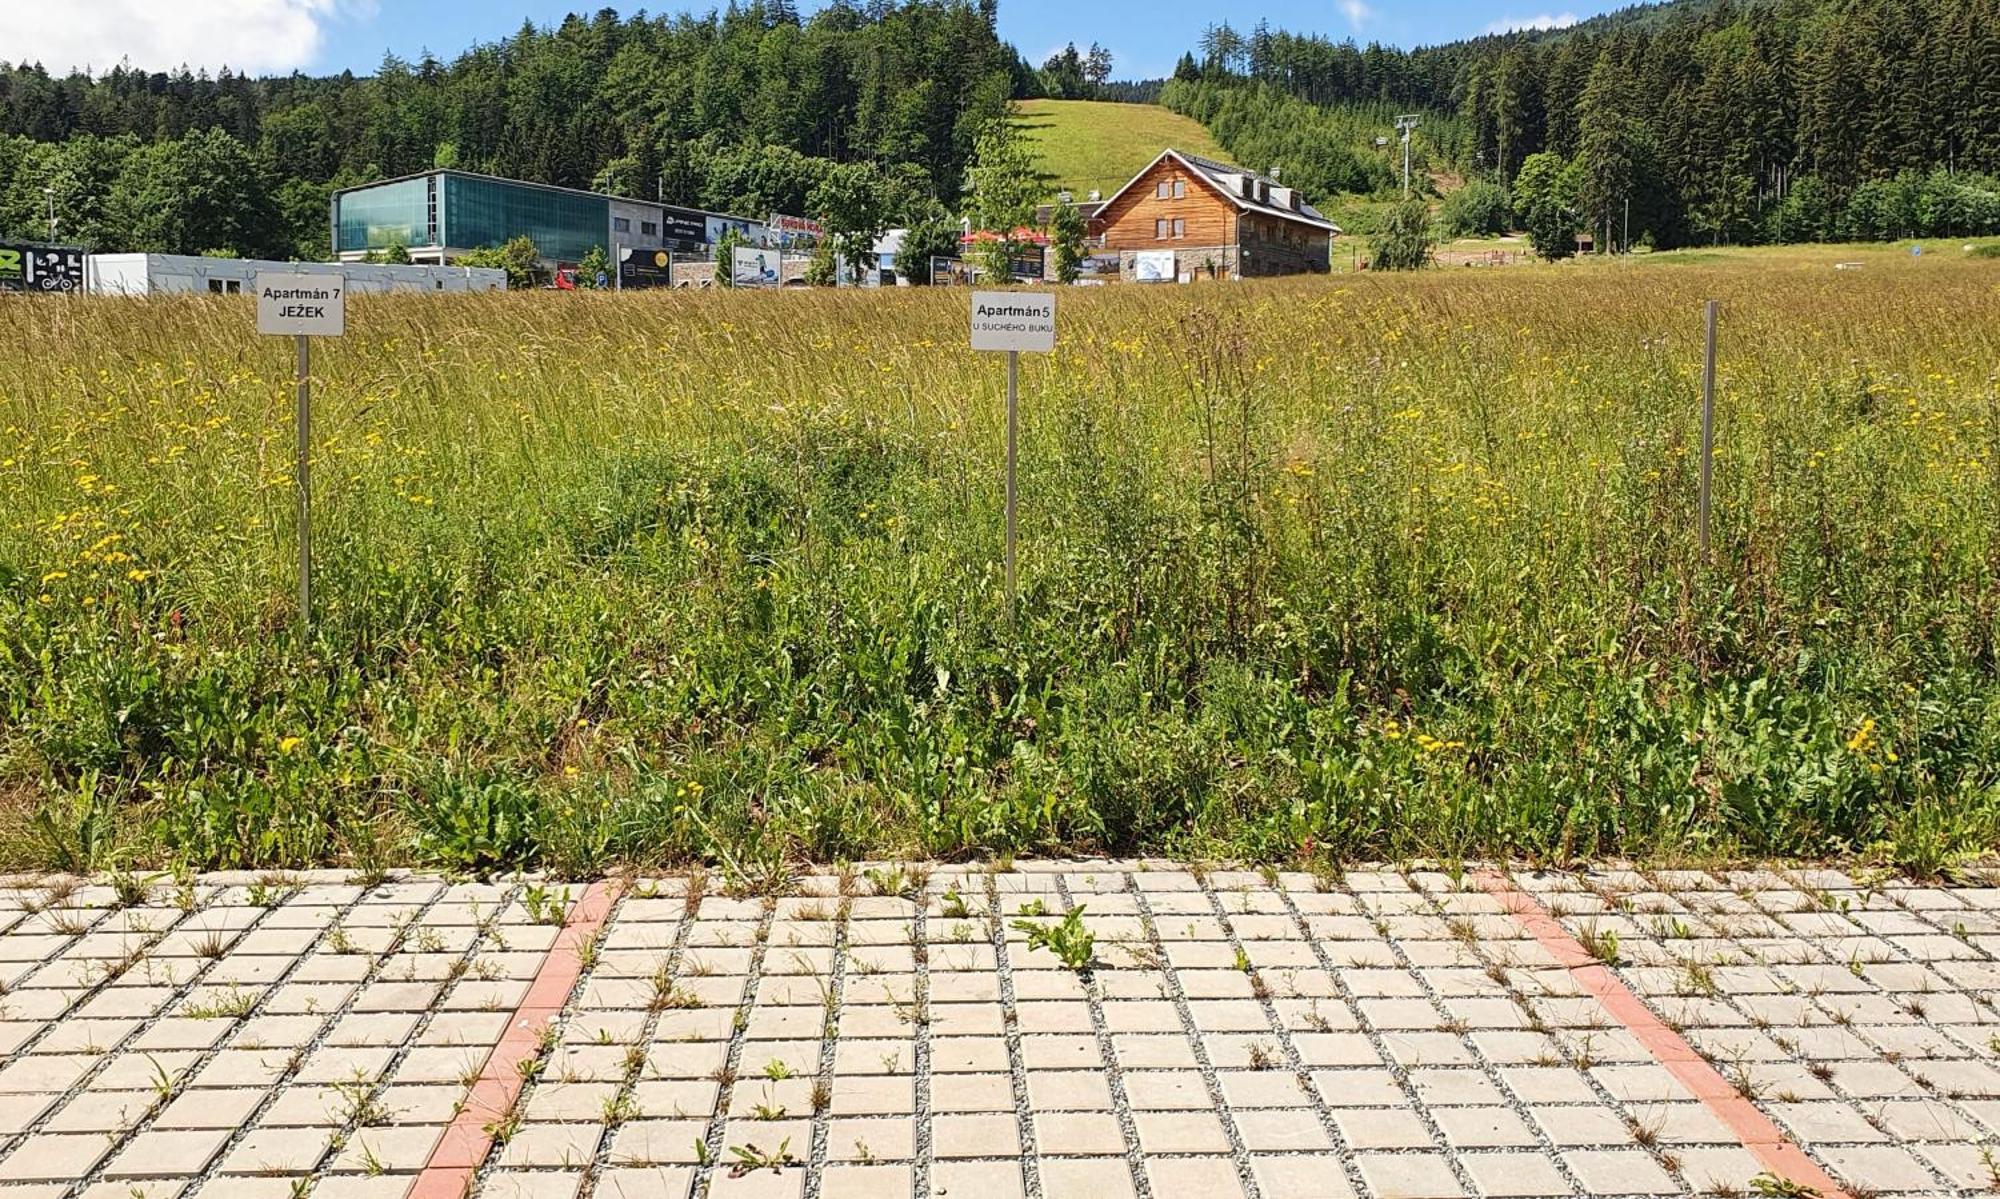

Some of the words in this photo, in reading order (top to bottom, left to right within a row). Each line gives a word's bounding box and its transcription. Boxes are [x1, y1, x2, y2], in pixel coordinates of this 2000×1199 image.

[263, 287, 329, 301] Apartmán
[332, 288, 341, 300] 7
[279, 304, 325, 318] JEŽEK
[977, 304, 1041, 317] Apartmán
[1042, 306, 1050, 318] 5
[982, 322, 1026, 332] SUCHÉHO
[1028, 324, 1053, 333] BUKU
